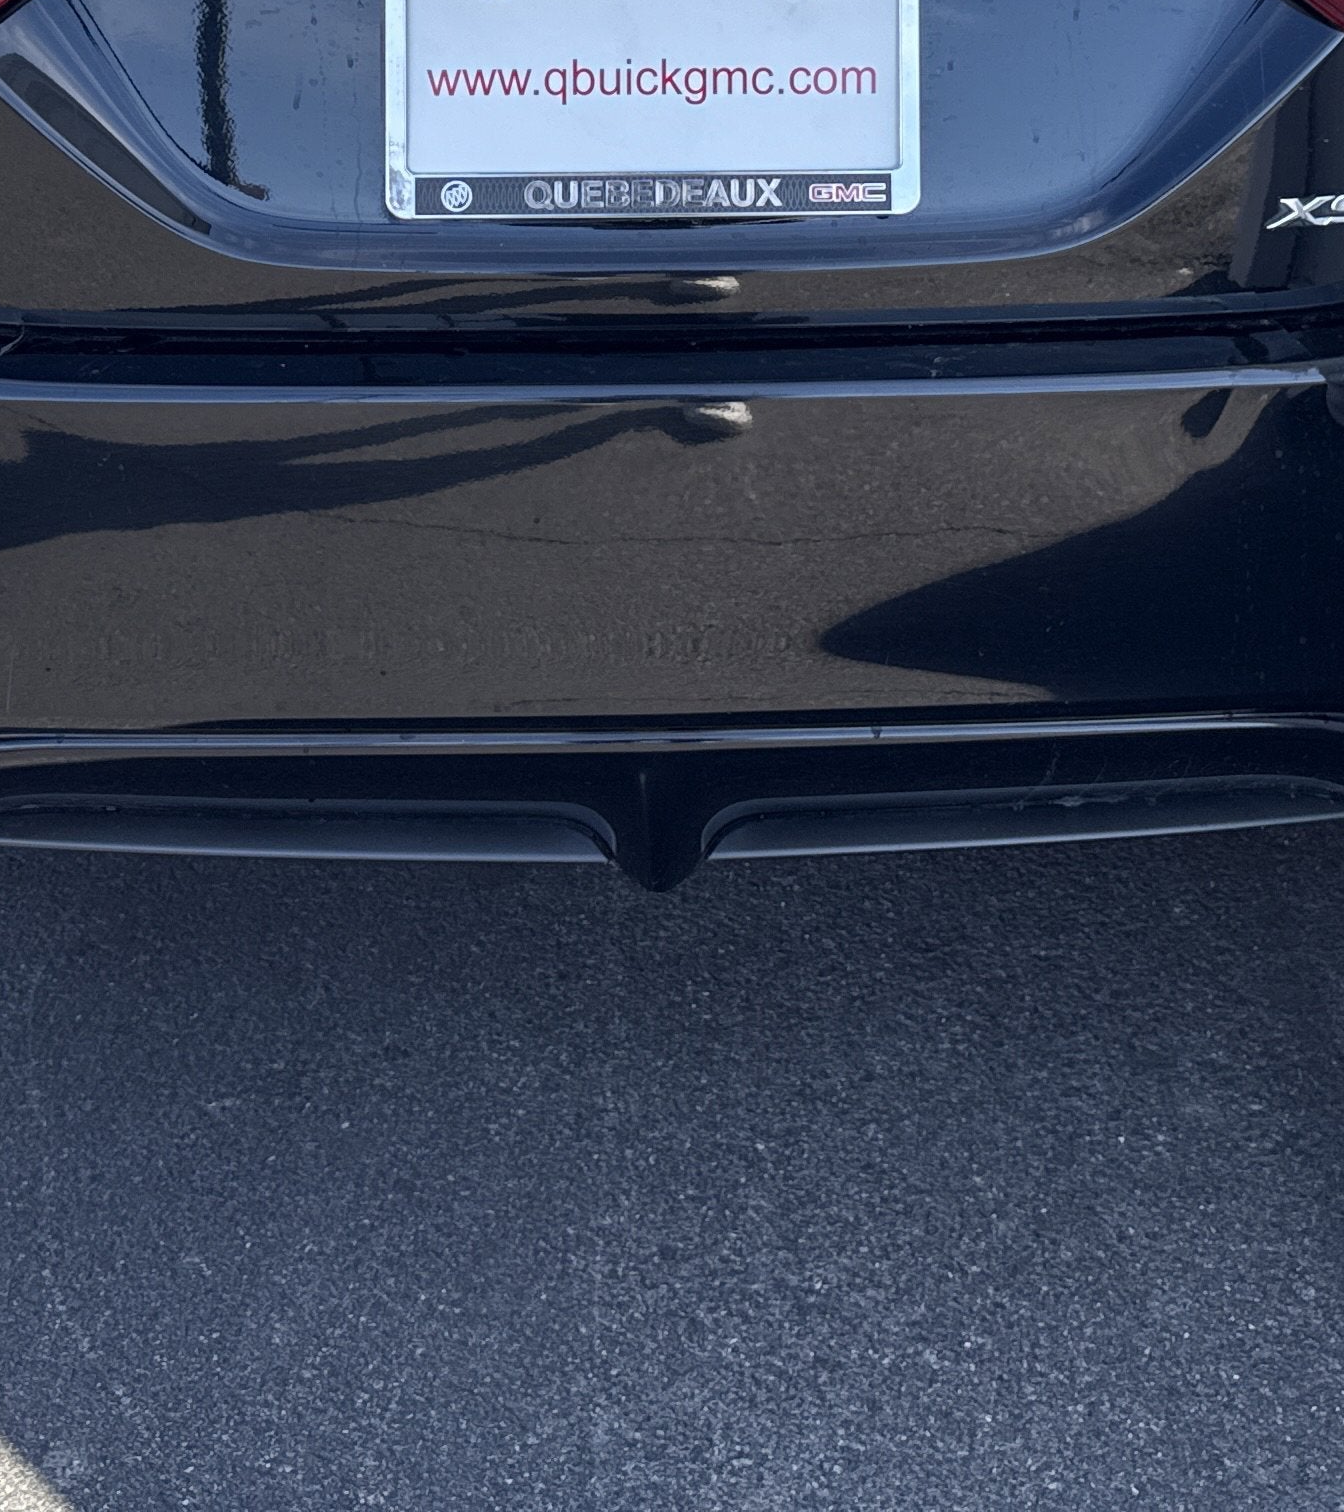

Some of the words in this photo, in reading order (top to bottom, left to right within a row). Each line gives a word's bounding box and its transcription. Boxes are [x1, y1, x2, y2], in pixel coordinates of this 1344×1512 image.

[427, 59, 878, 105] www.qbuickgmc.com
[523, 178, 783, 210] QUEBEDEAUX
[808, 183, 887, 203] GMC
